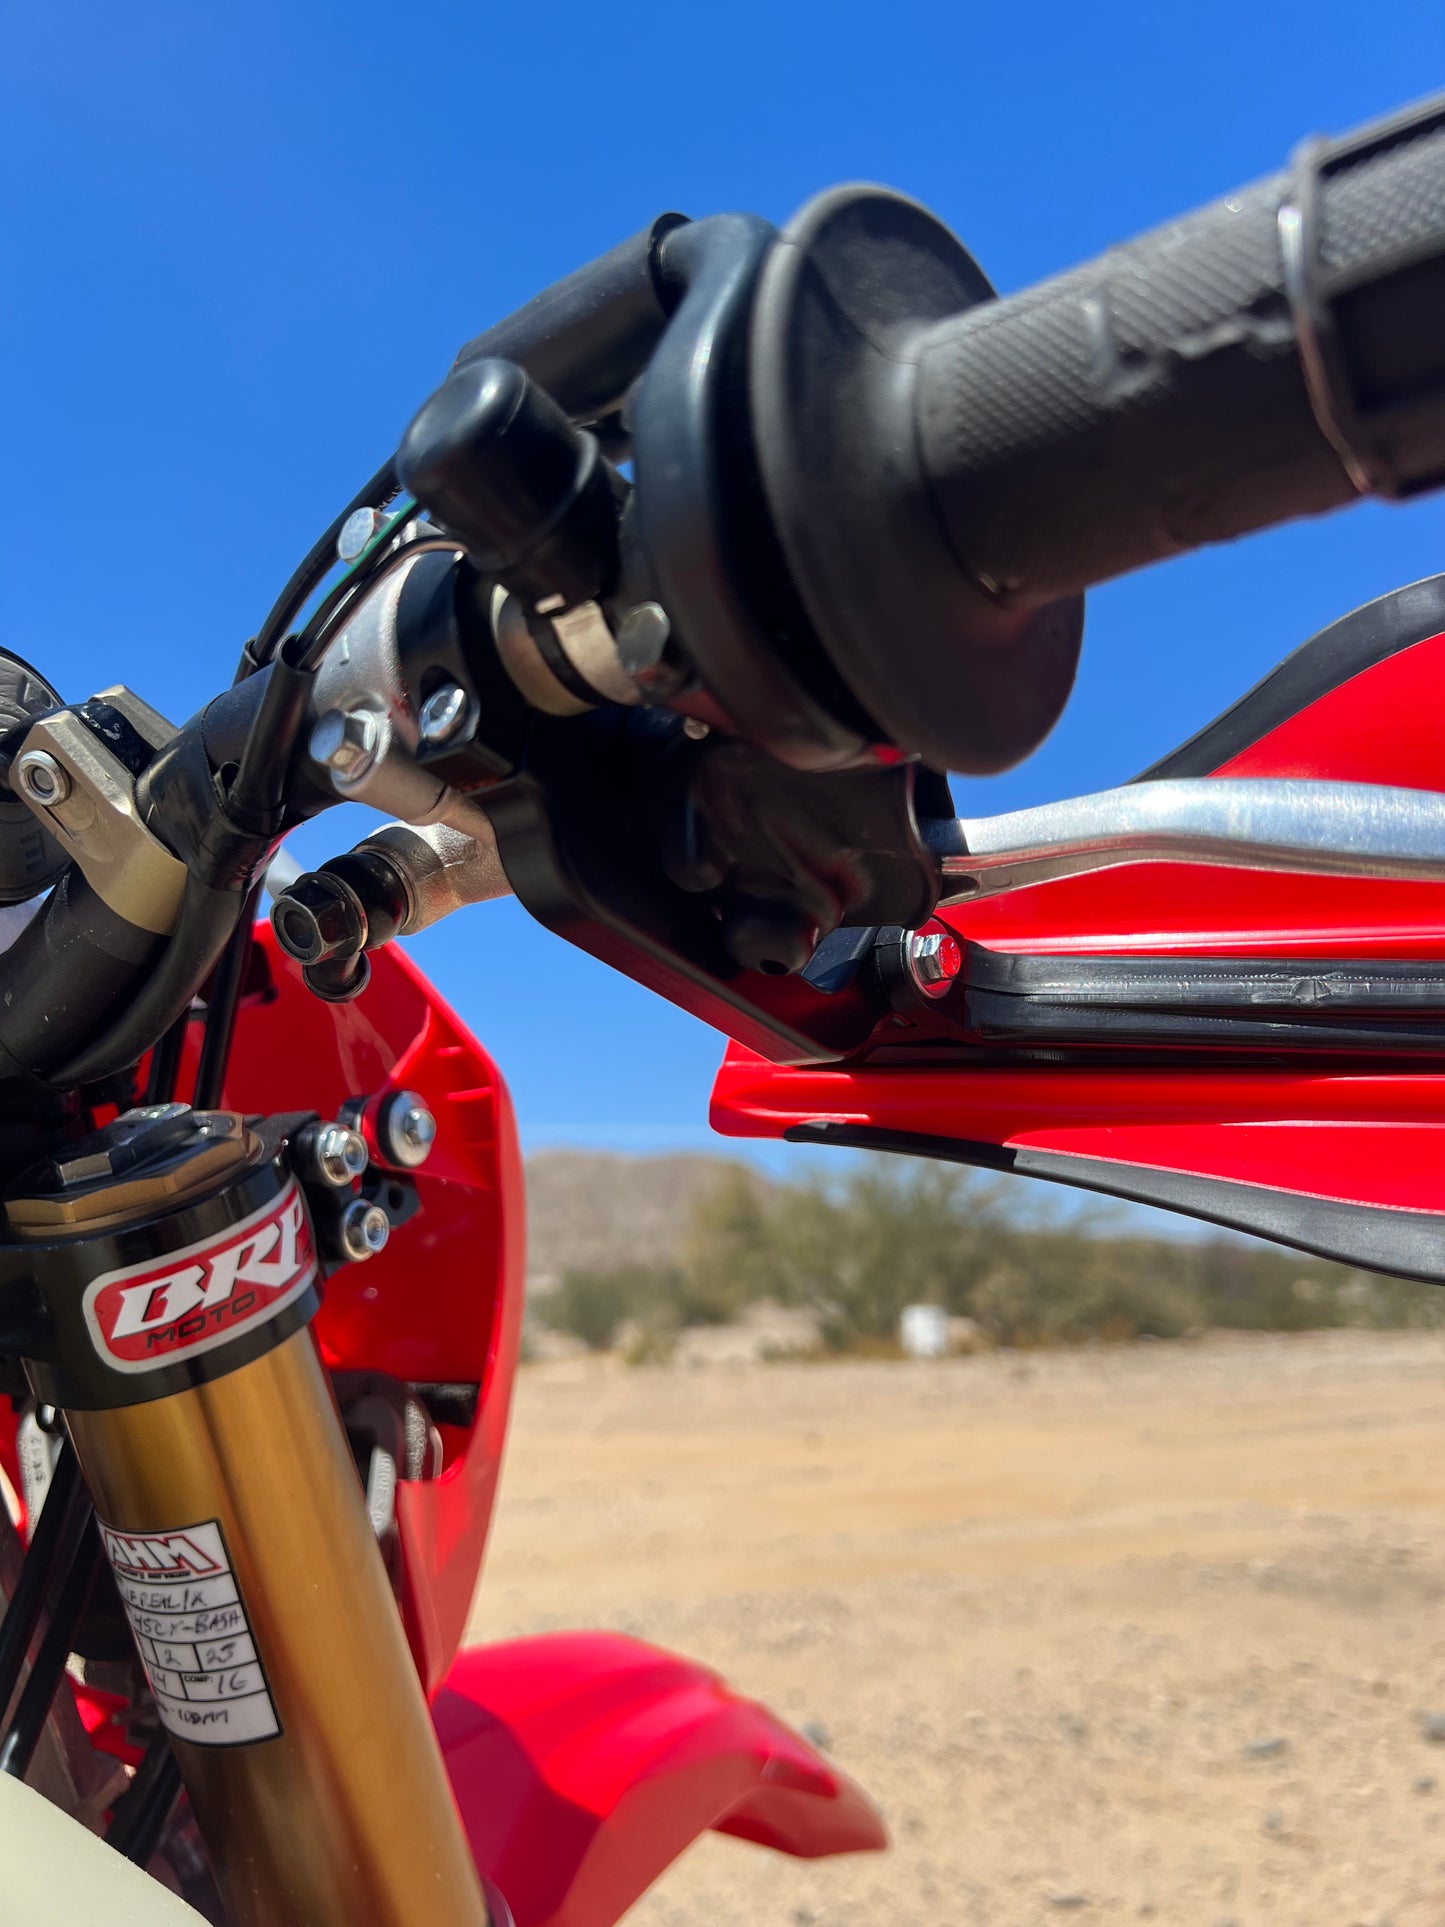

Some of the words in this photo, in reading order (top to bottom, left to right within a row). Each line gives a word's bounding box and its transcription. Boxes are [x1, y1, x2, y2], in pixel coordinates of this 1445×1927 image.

[146, 1291, 255, 1349] MOTO
[104, 1530, 222, 1574] AHM
[164, 1648, 181, 1665] 2
